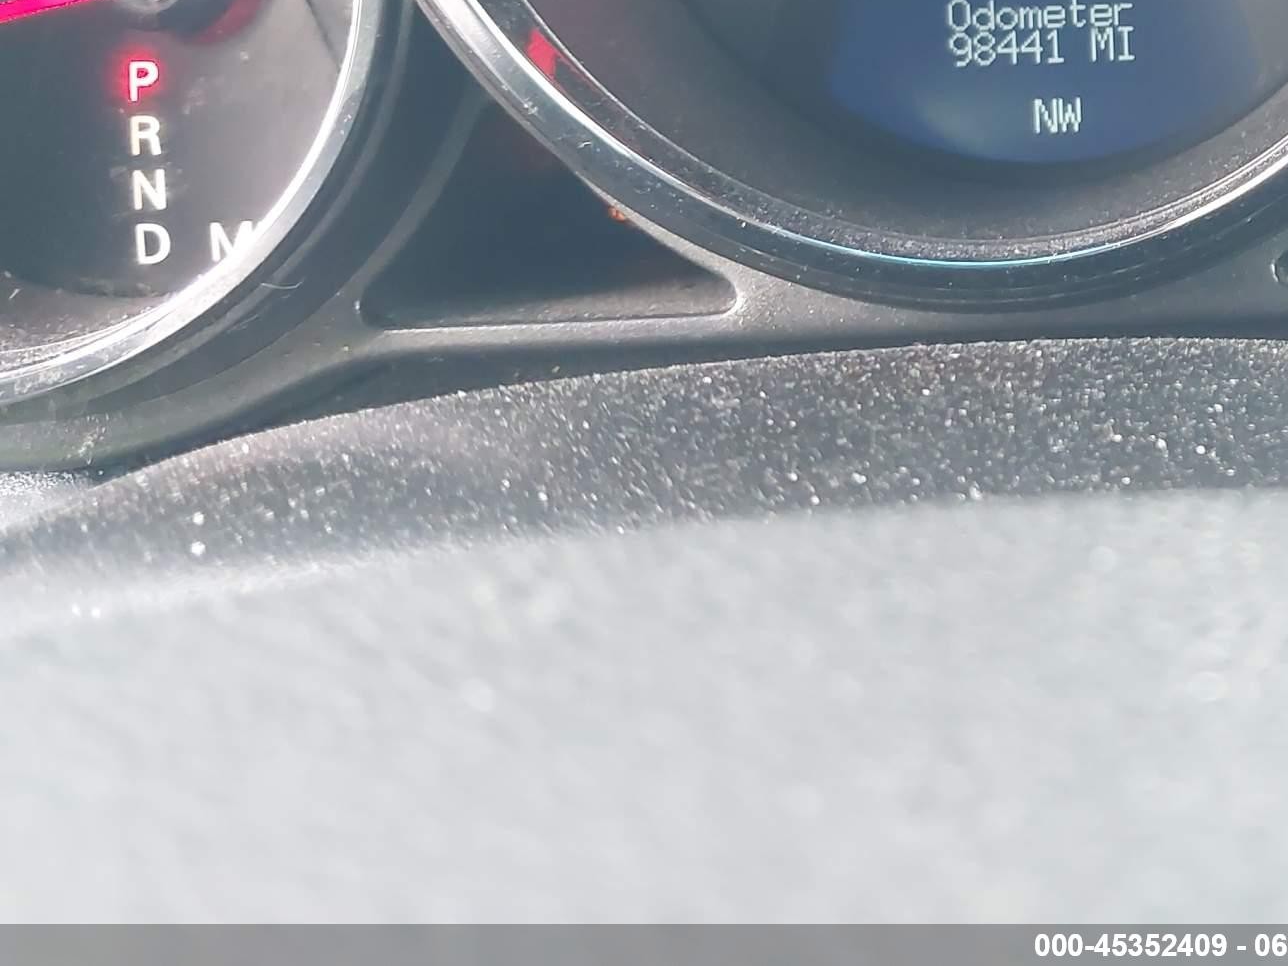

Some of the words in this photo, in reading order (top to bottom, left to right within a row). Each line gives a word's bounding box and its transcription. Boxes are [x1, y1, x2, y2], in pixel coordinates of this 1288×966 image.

[949, 29, 1065, 67] 98441
[1090, 25, 1136, 63] MI
[129, 60, 159, 102] P
[129, 115, 162, 156] R
[1032, 97, 1083, 135] NW
[132, 168, 167, 210] N
[135, 223, 171, 265] D
